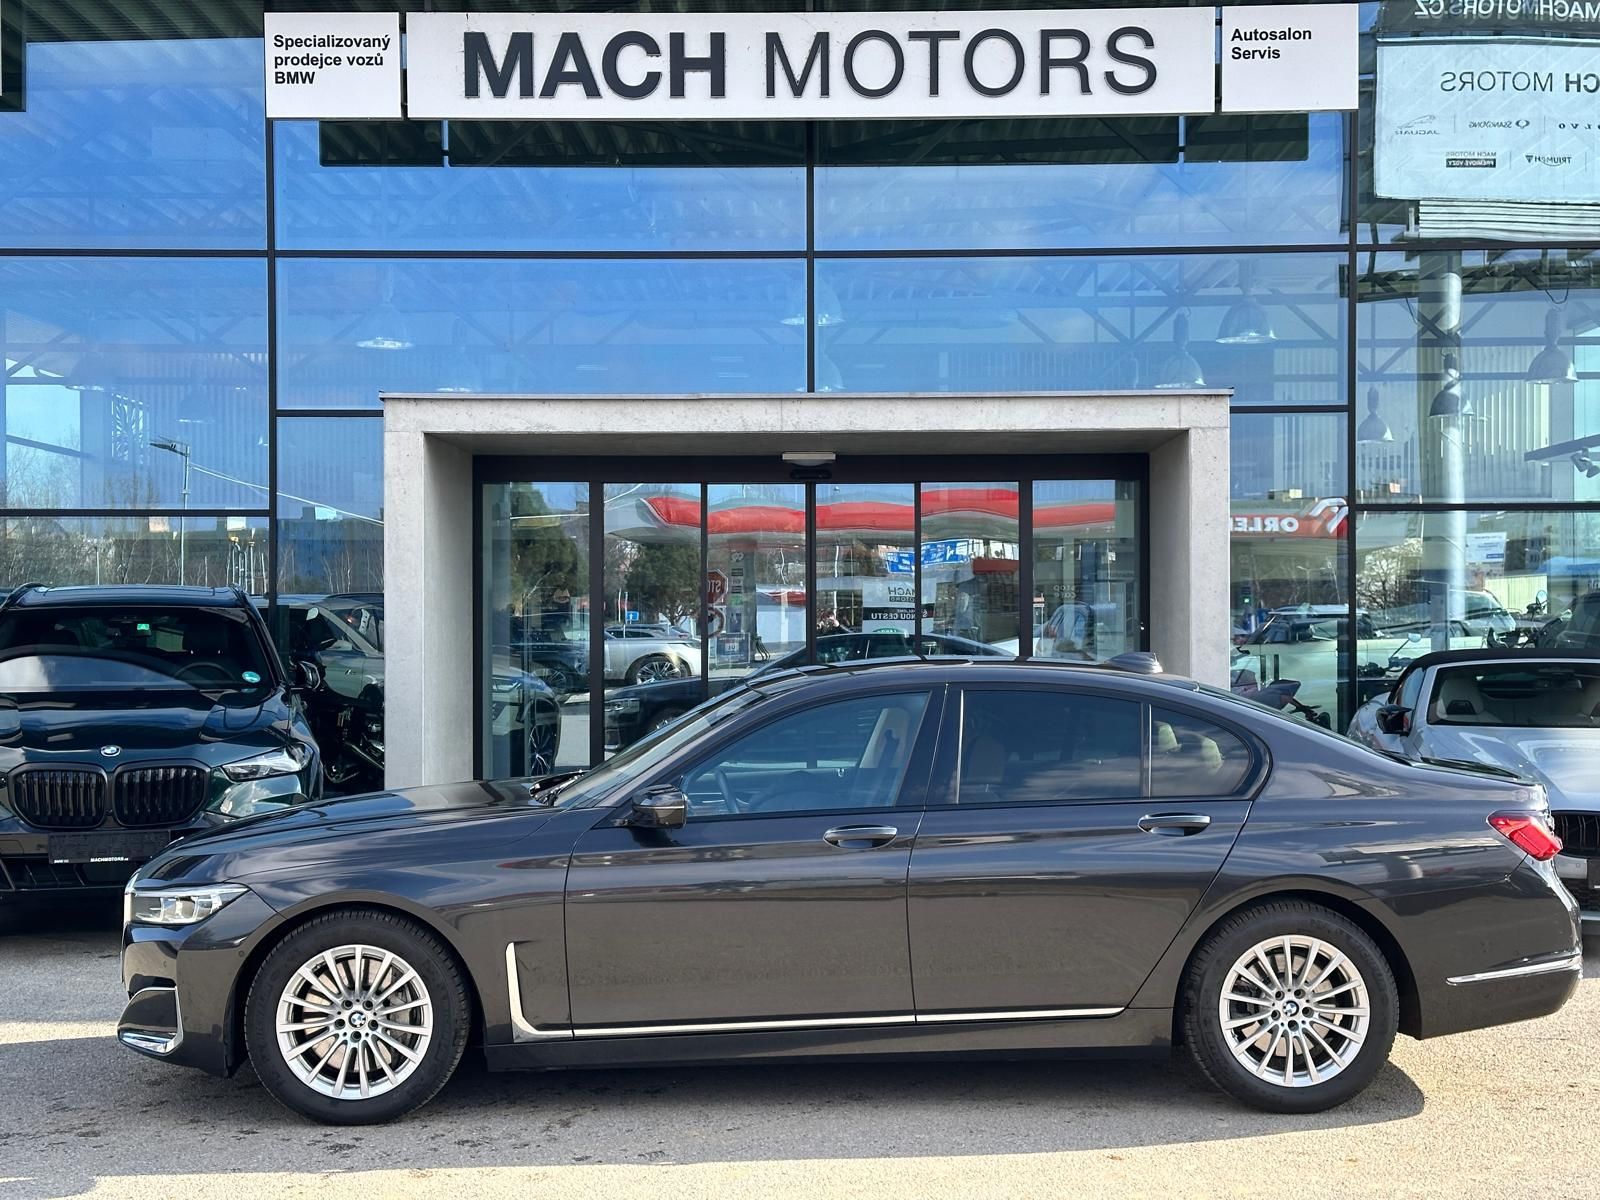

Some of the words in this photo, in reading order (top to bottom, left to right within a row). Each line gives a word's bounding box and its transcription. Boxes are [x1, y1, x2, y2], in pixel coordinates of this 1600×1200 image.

[1230, 27, 1312, 41] Autosalon
[273, 34, 391, 51] Specializovaný
[1231, 46, 1281, 60] Servis
[274, 53, 342, 69] prodejce
[346, 53, 384, 66] vozů
[463, 31, 726, 100] MACH
[765, 27, 1157, 99] MOTORS
[274, 71, 316, 84] BMW
